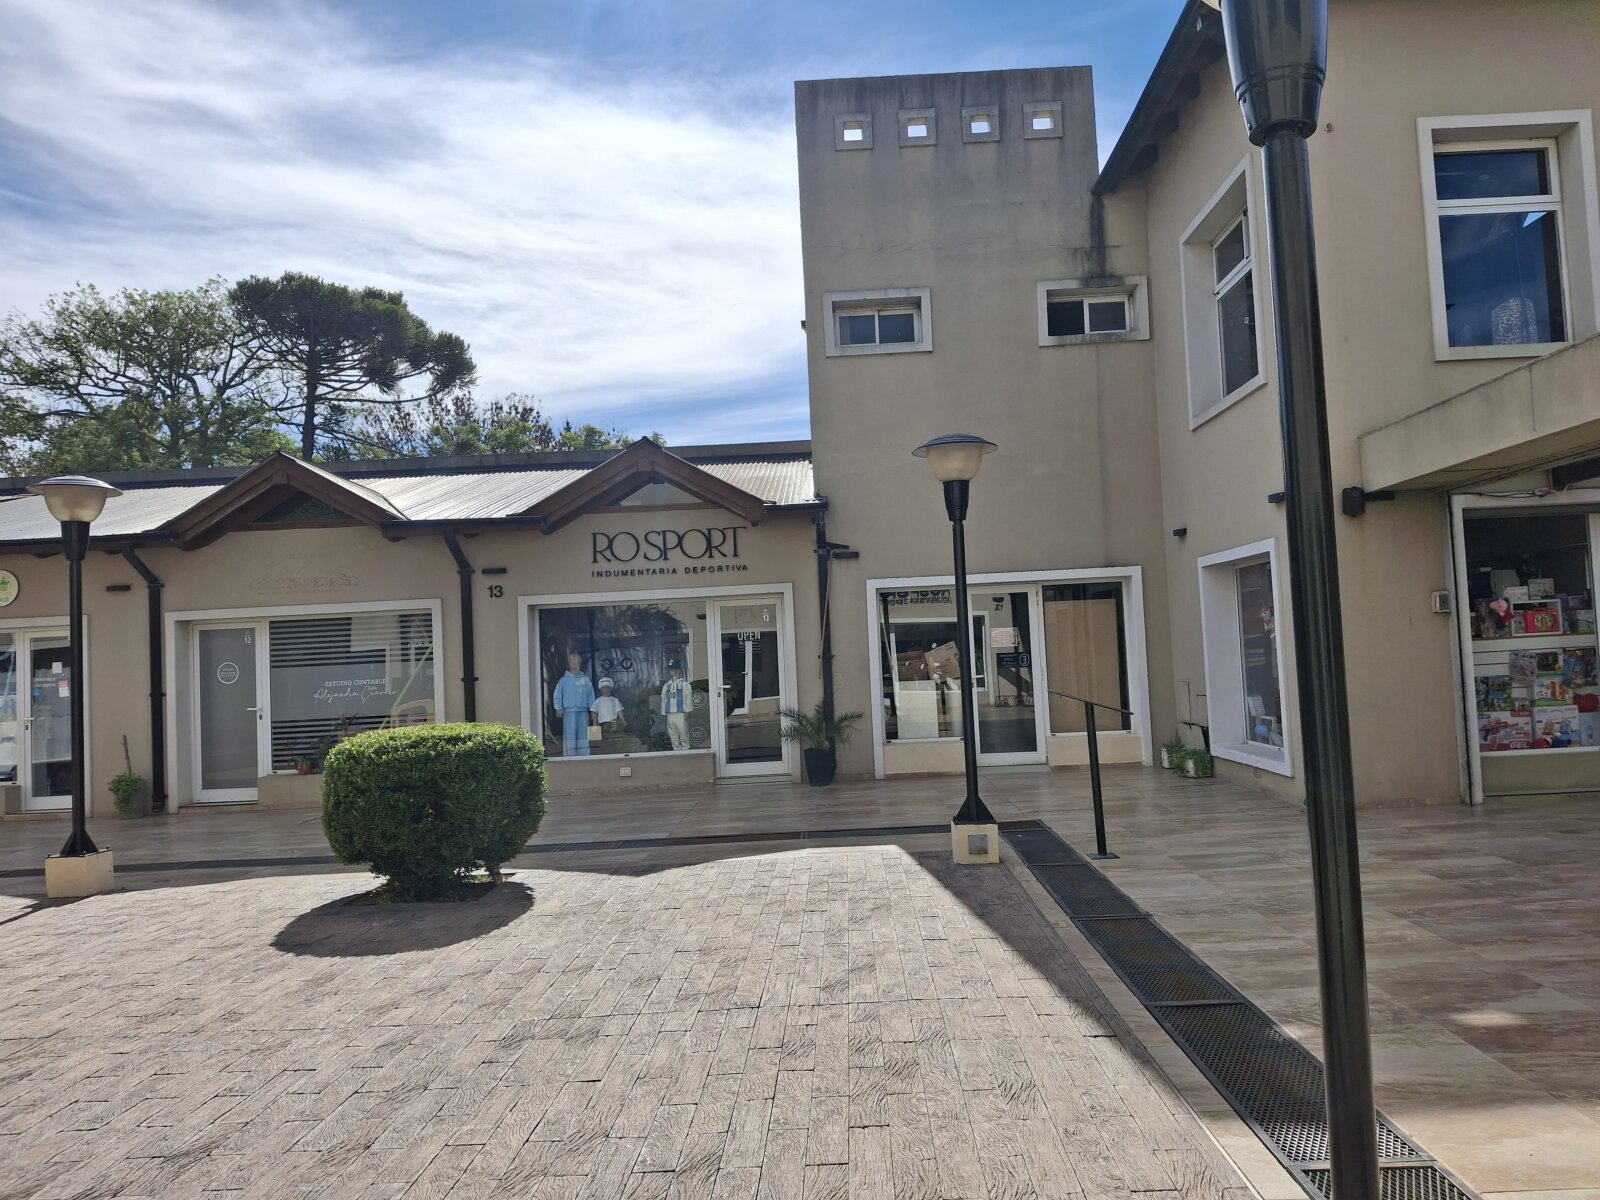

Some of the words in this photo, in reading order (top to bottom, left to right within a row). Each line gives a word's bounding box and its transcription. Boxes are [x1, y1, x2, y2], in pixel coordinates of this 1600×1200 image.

[643, 526, 748, 562] SPORT
[591, 567, 678, 578] INDUMENTARIA
[684, 564, 748, 574] DEPORTIVA
[487, 585, 503, 598] 13
[763, 614, 770, 622] 13
[737, 630, 761, 641] OPEN
